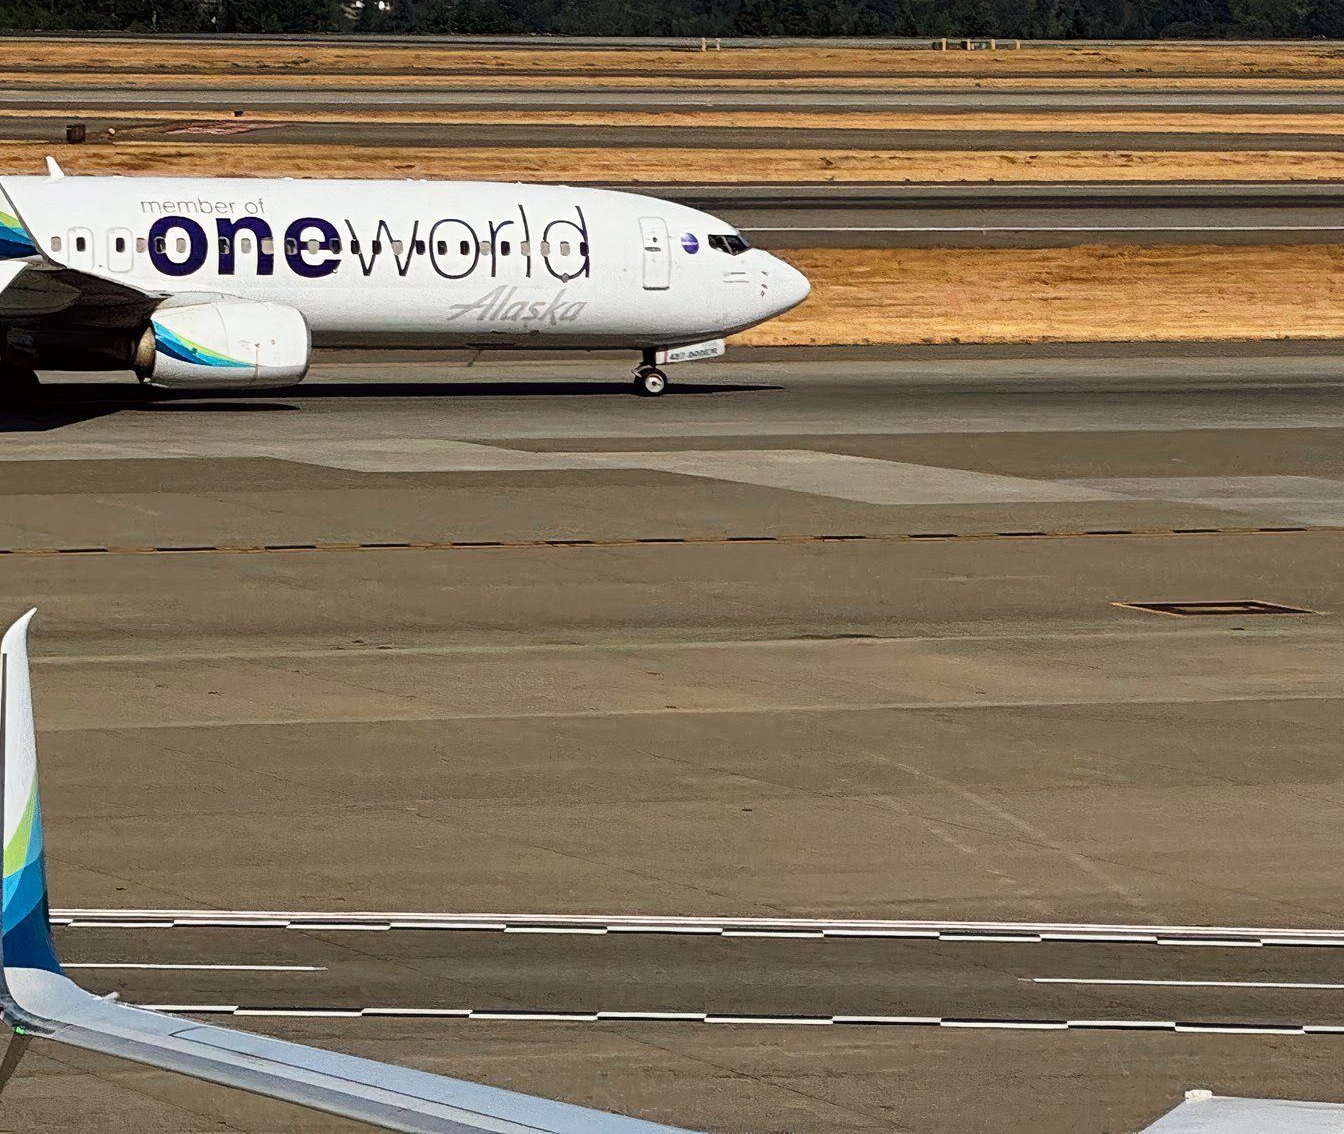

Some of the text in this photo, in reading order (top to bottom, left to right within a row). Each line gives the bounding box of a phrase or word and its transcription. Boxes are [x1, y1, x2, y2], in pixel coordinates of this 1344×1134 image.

[141, 197, 266, 215] member of
[147, 204, 591, 281] oneworld
[446, 284, 589, 326] Alaska
